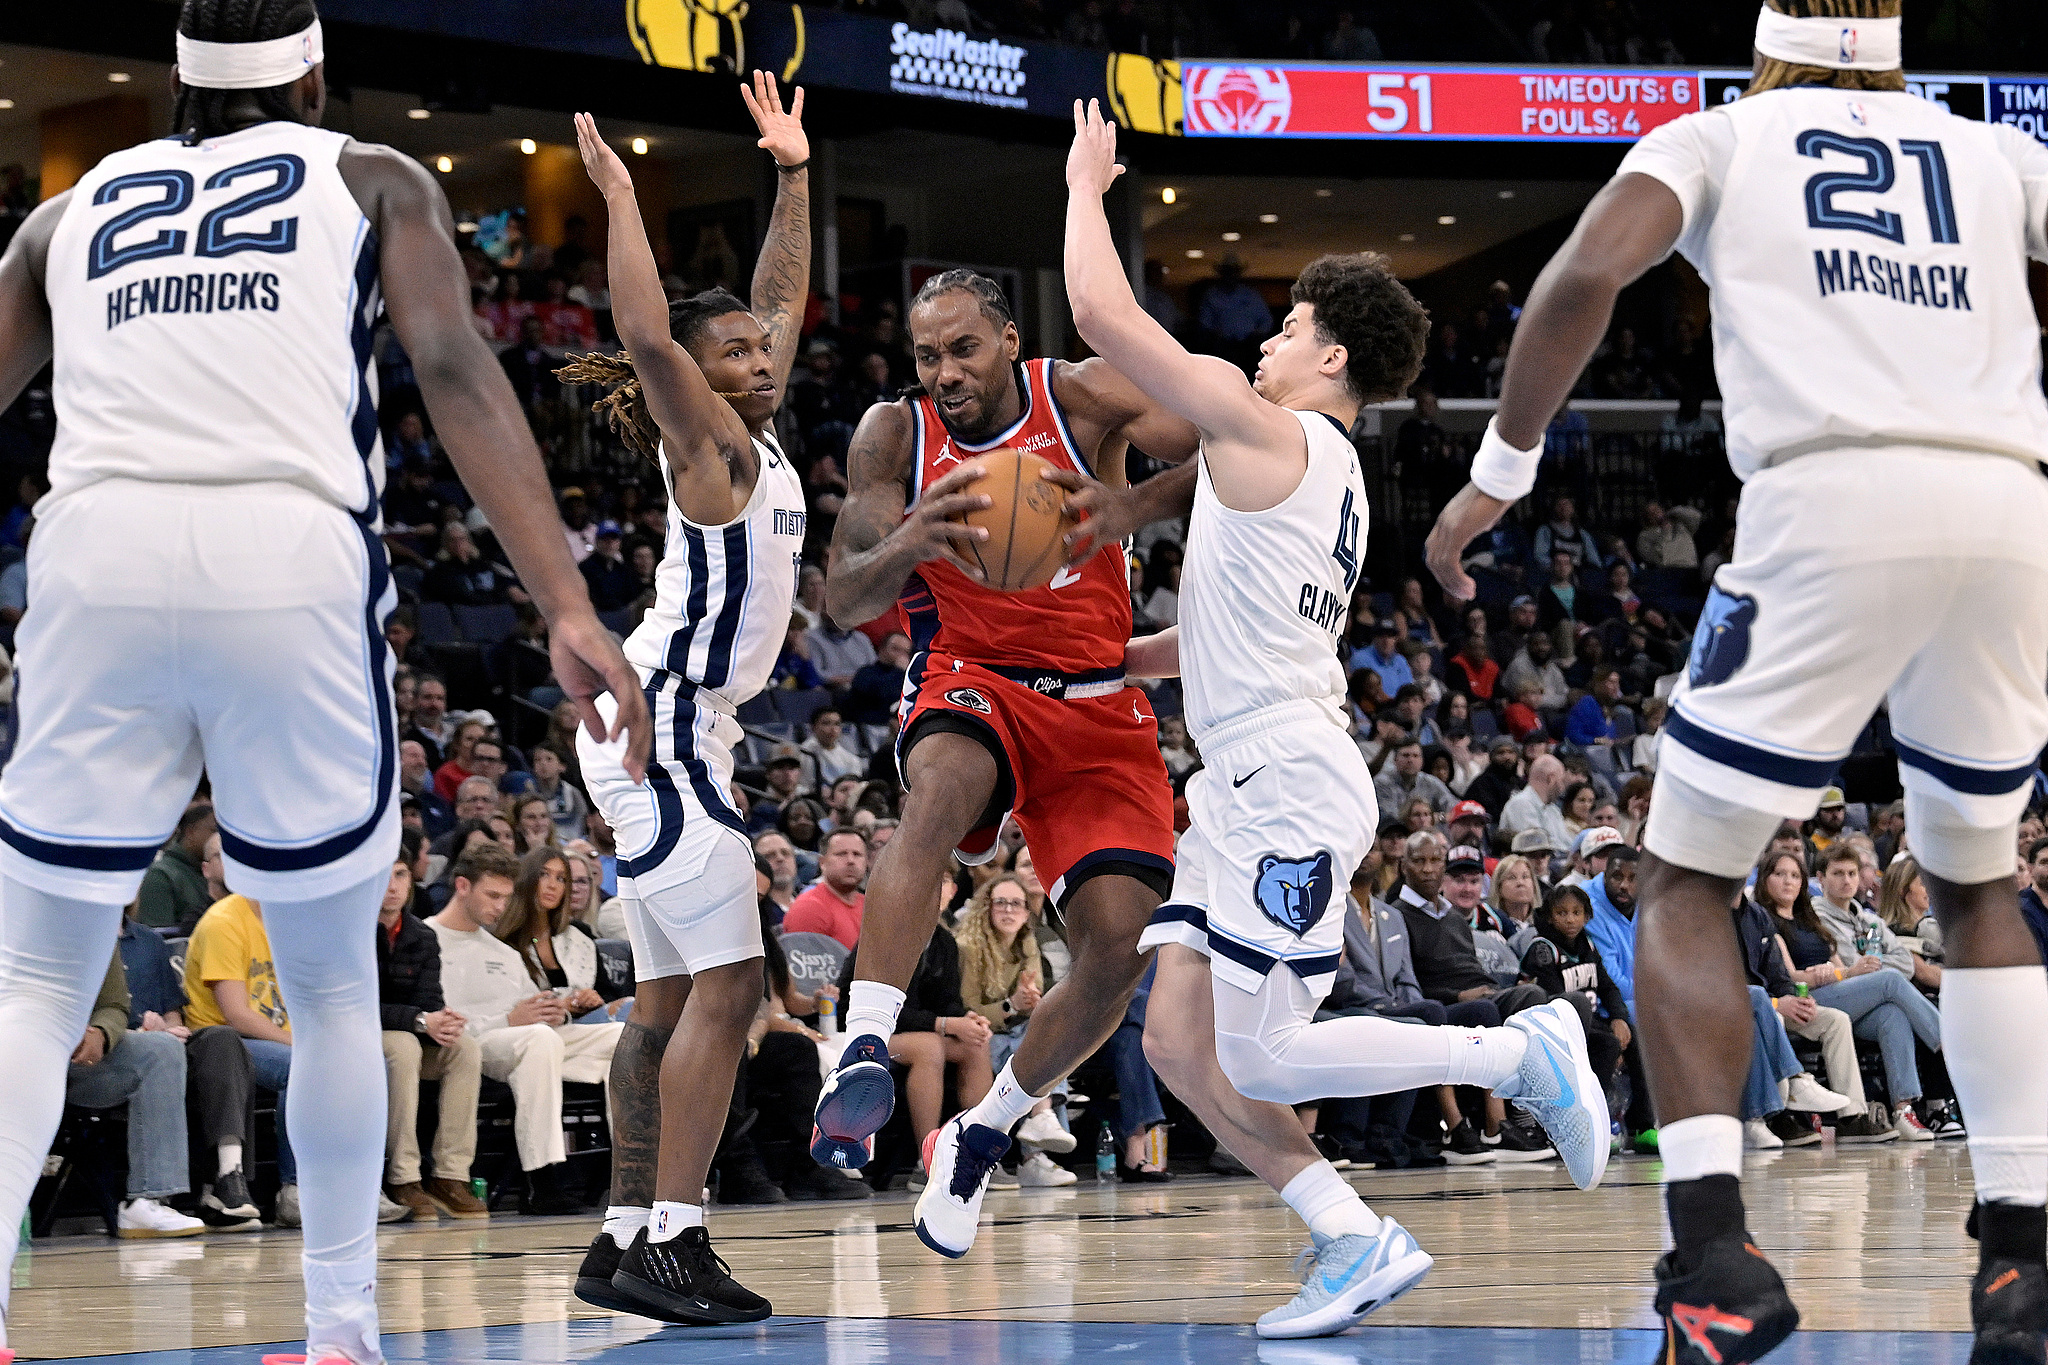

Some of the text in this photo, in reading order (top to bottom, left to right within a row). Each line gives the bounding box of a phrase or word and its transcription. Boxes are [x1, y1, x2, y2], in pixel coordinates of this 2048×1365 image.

[890, 22, 1028, 71] SealMaster
[1367, 74, 1432, 132] 51
[1520, 77, 1691, 104] TIMEOUTS: 6
[1999, 84, 2048, 111] TIM
[1521, 107, 1641, 134] FOULS: 4
[1796, 129, 1960, 245] 21
[87, 153, 306, 281] 22
[107, 271, 280, 330] HENDRICKS
[1814, 249, 1971, 311] MASHACK
[1024, 431, 1047, 446] VISIT
[1332, 486, 1359, 594] 4
[1034, 676, 1062, 693] Clips
